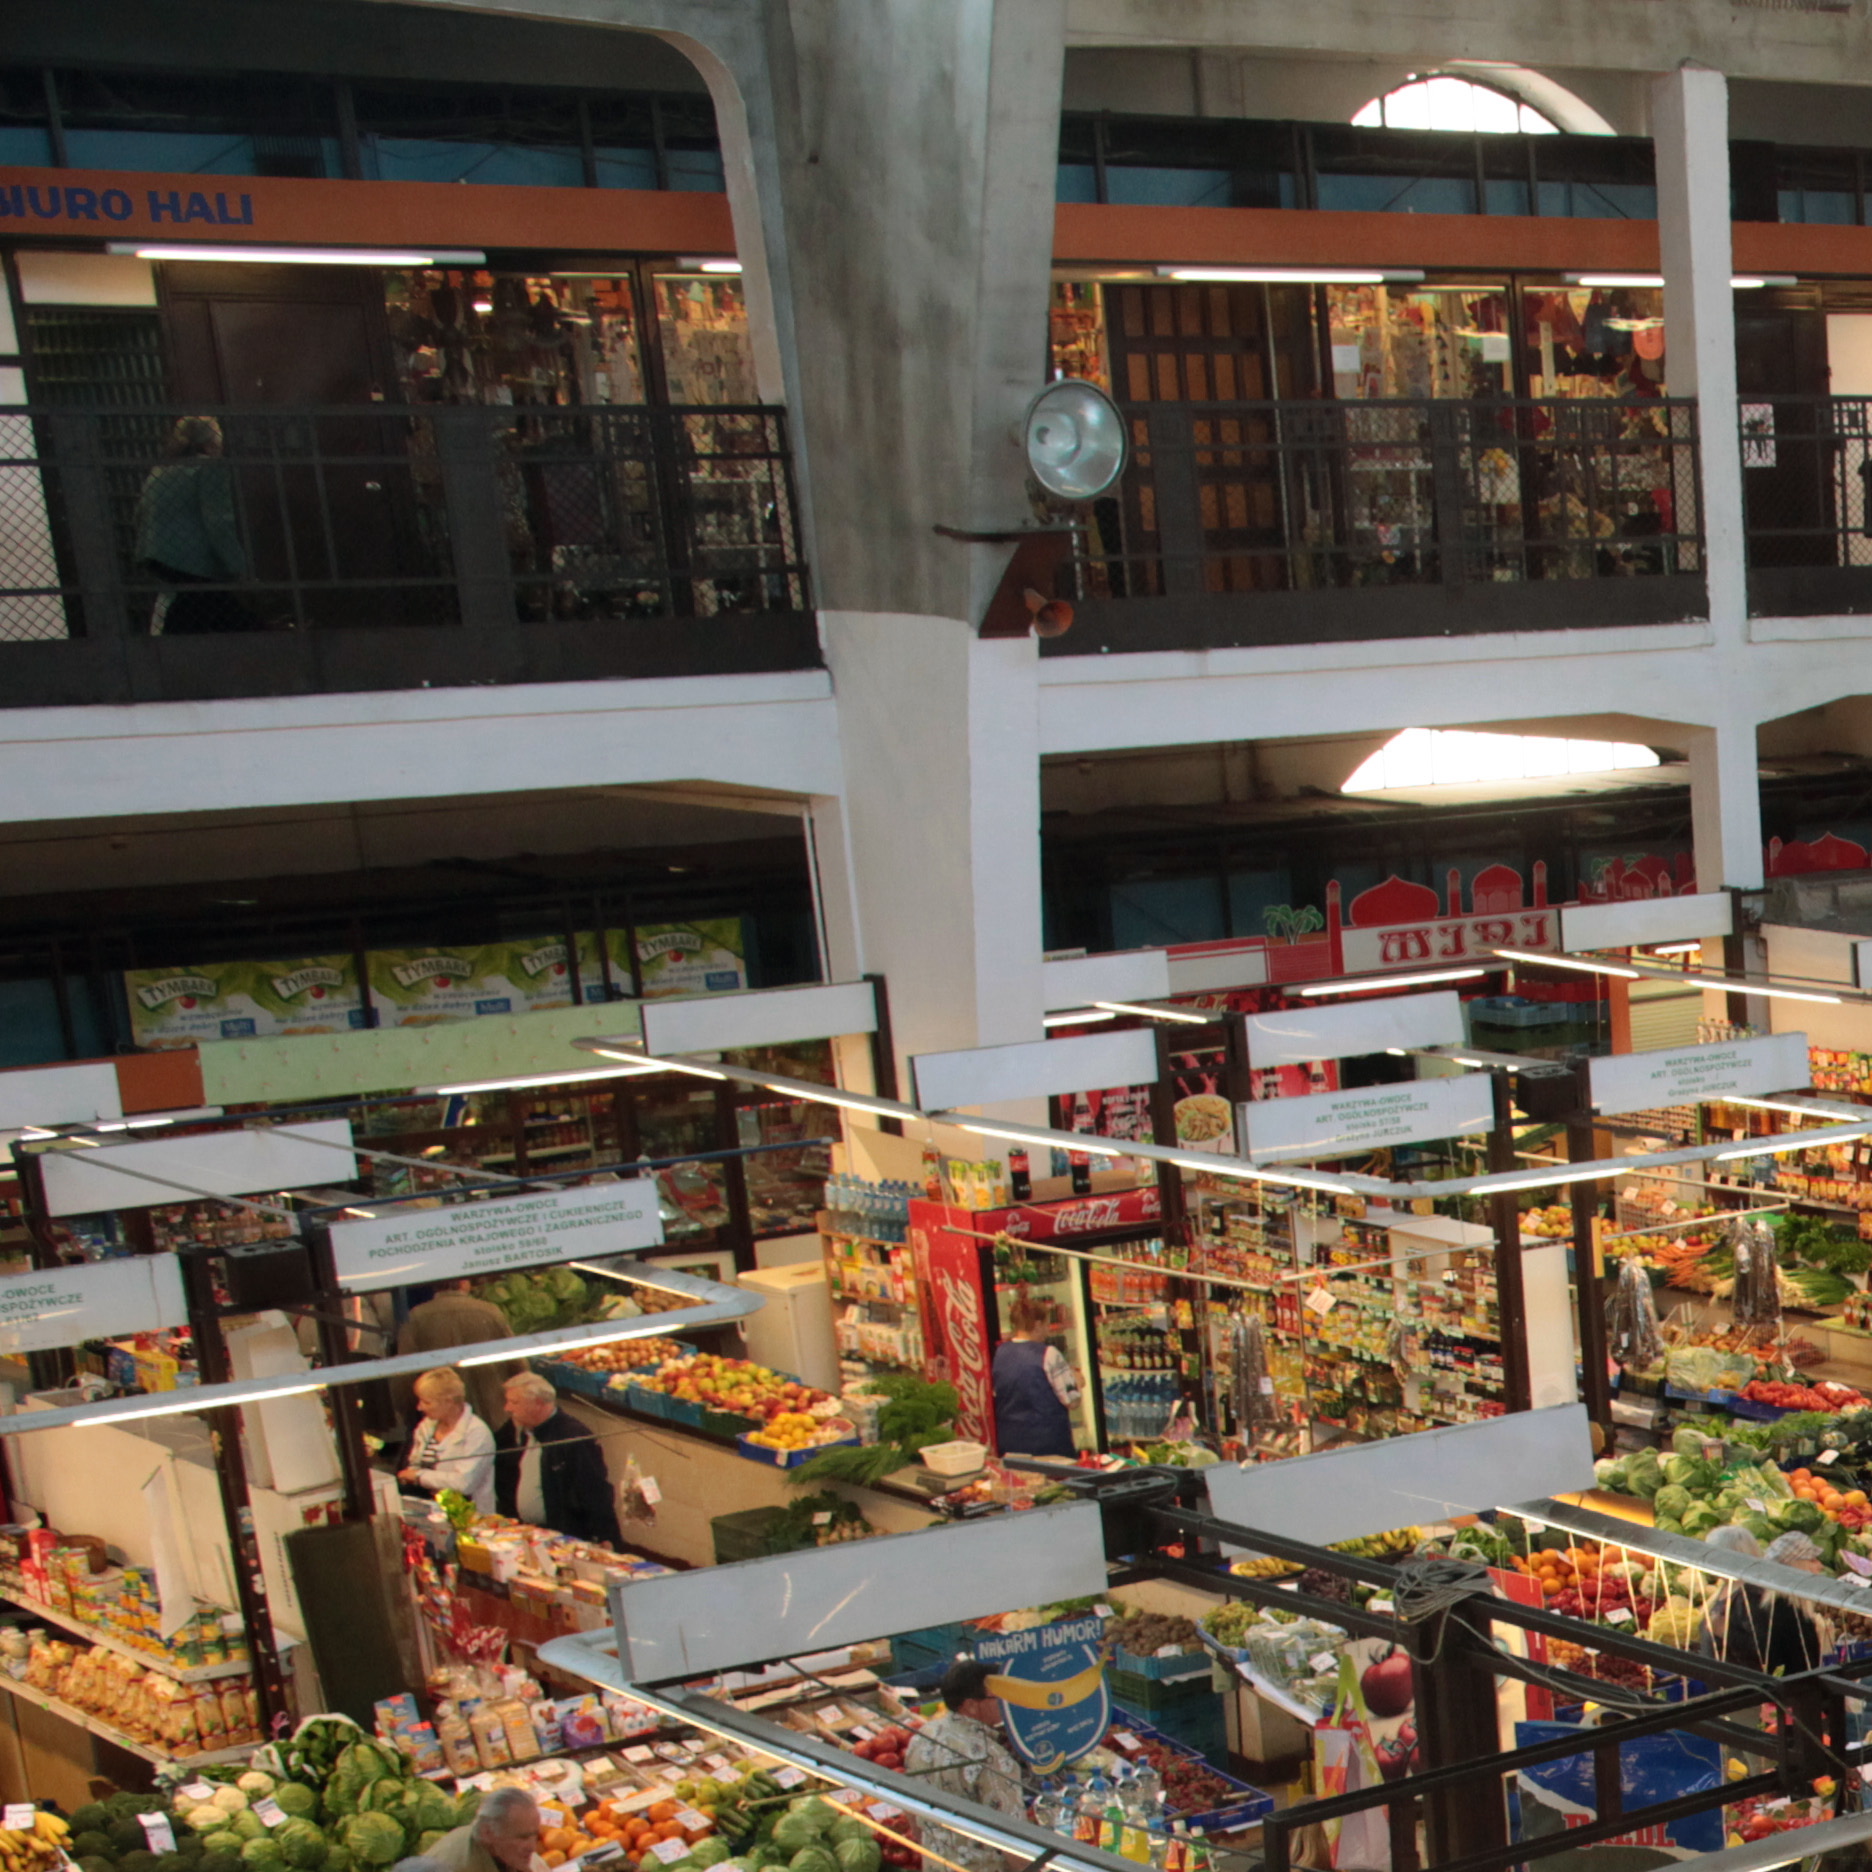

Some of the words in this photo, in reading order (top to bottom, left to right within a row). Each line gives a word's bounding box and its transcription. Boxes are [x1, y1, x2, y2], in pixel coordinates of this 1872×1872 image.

[147, 190, 253, 225] HALI
[638, 934, 702, 962] TYMBARK
[279, 966, 343, 995] TYMBARK
[393, 956, 473, 988] TYMBARK
[143, 977, 218, 1004] TYMBARK
[1664, 1050, 1738, 1068] WARZYWA-OWOCE
[1331, 1093, 1413, 1112] WARZYWA-OWOCE
[450, 1198, 559, 1222] WARZYWA-OWOCE
[549, 1199, 626, 1219] CUKIERNICZE
[368, 1238, 455, 1258] POCHODZENIA
[458, 1225, 535, 1247] KRAJOWEGO
[544, 1210, 644, 1232] ZAGRANICZNEGO
[978, 1631, 1038, 1660] NAKARM
[1041, 1617, 1101, 1647] HUMOR!
